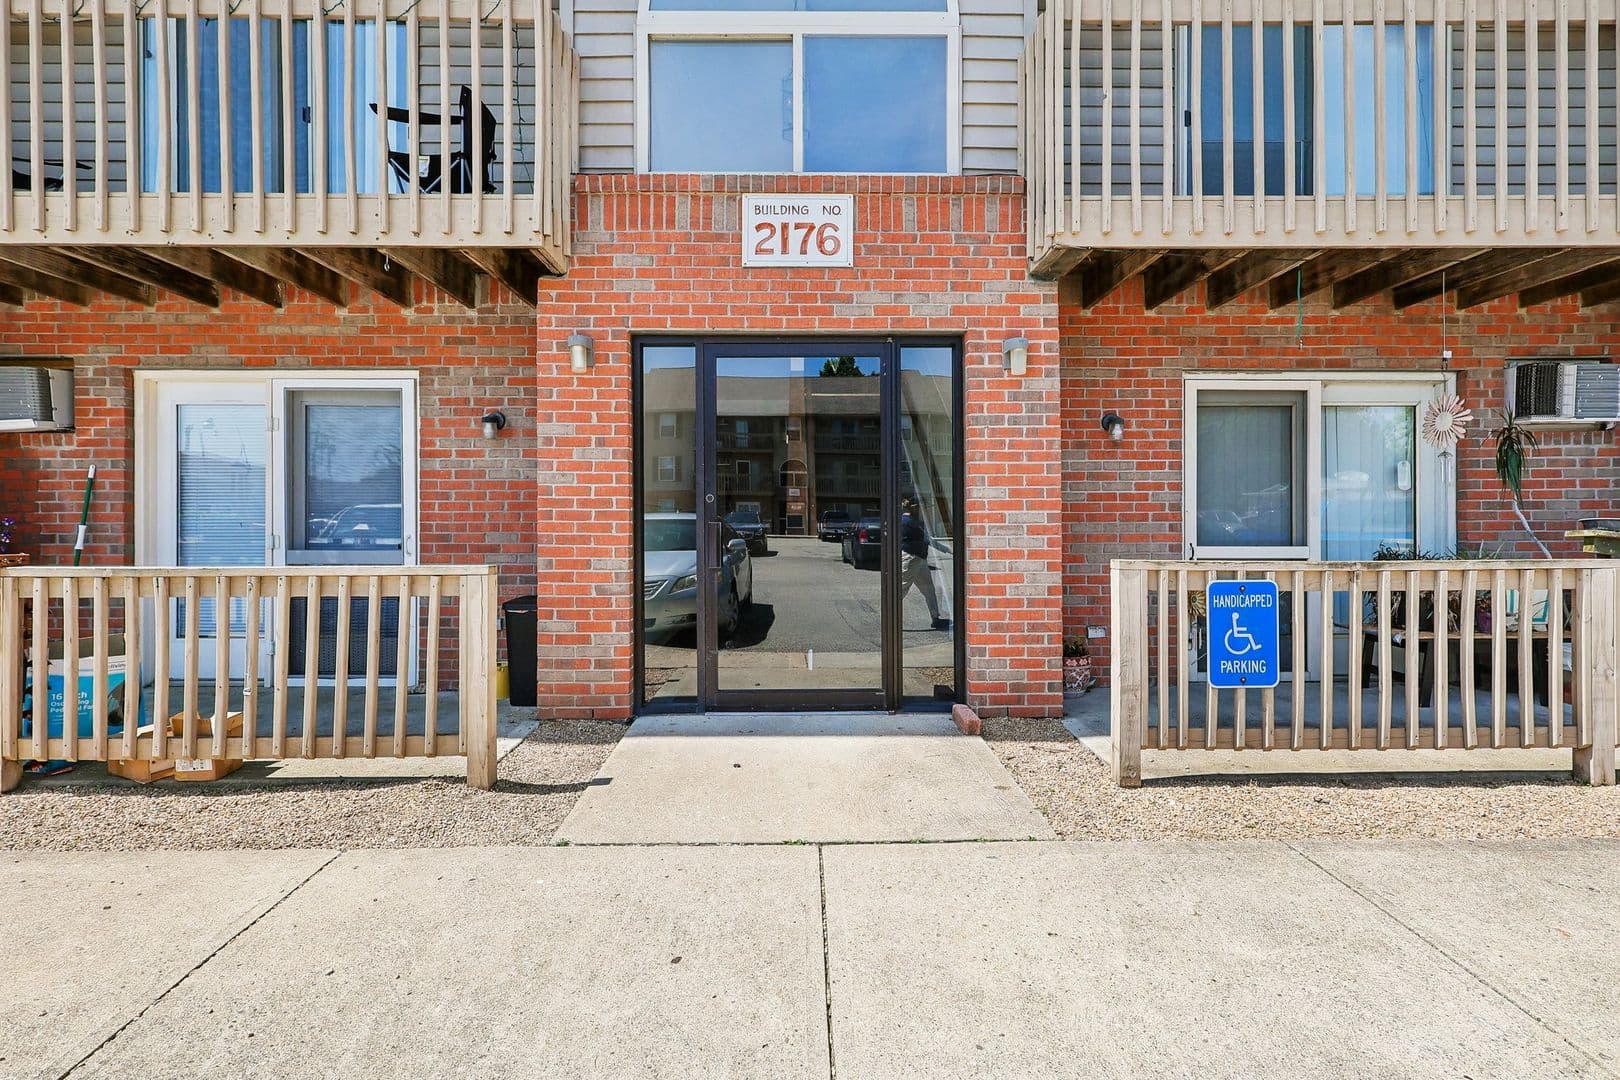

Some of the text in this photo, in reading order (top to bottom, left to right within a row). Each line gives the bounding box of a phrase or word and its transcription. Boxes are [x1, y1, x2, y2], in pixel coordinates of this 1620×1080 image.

[754, 205, 809, 215] BUILDING
[755, 222, 842, 256] 2176
[1213, 594, 1273, 608] HANDICAPPED
[1220, 660, 1266, 673] PARKING
